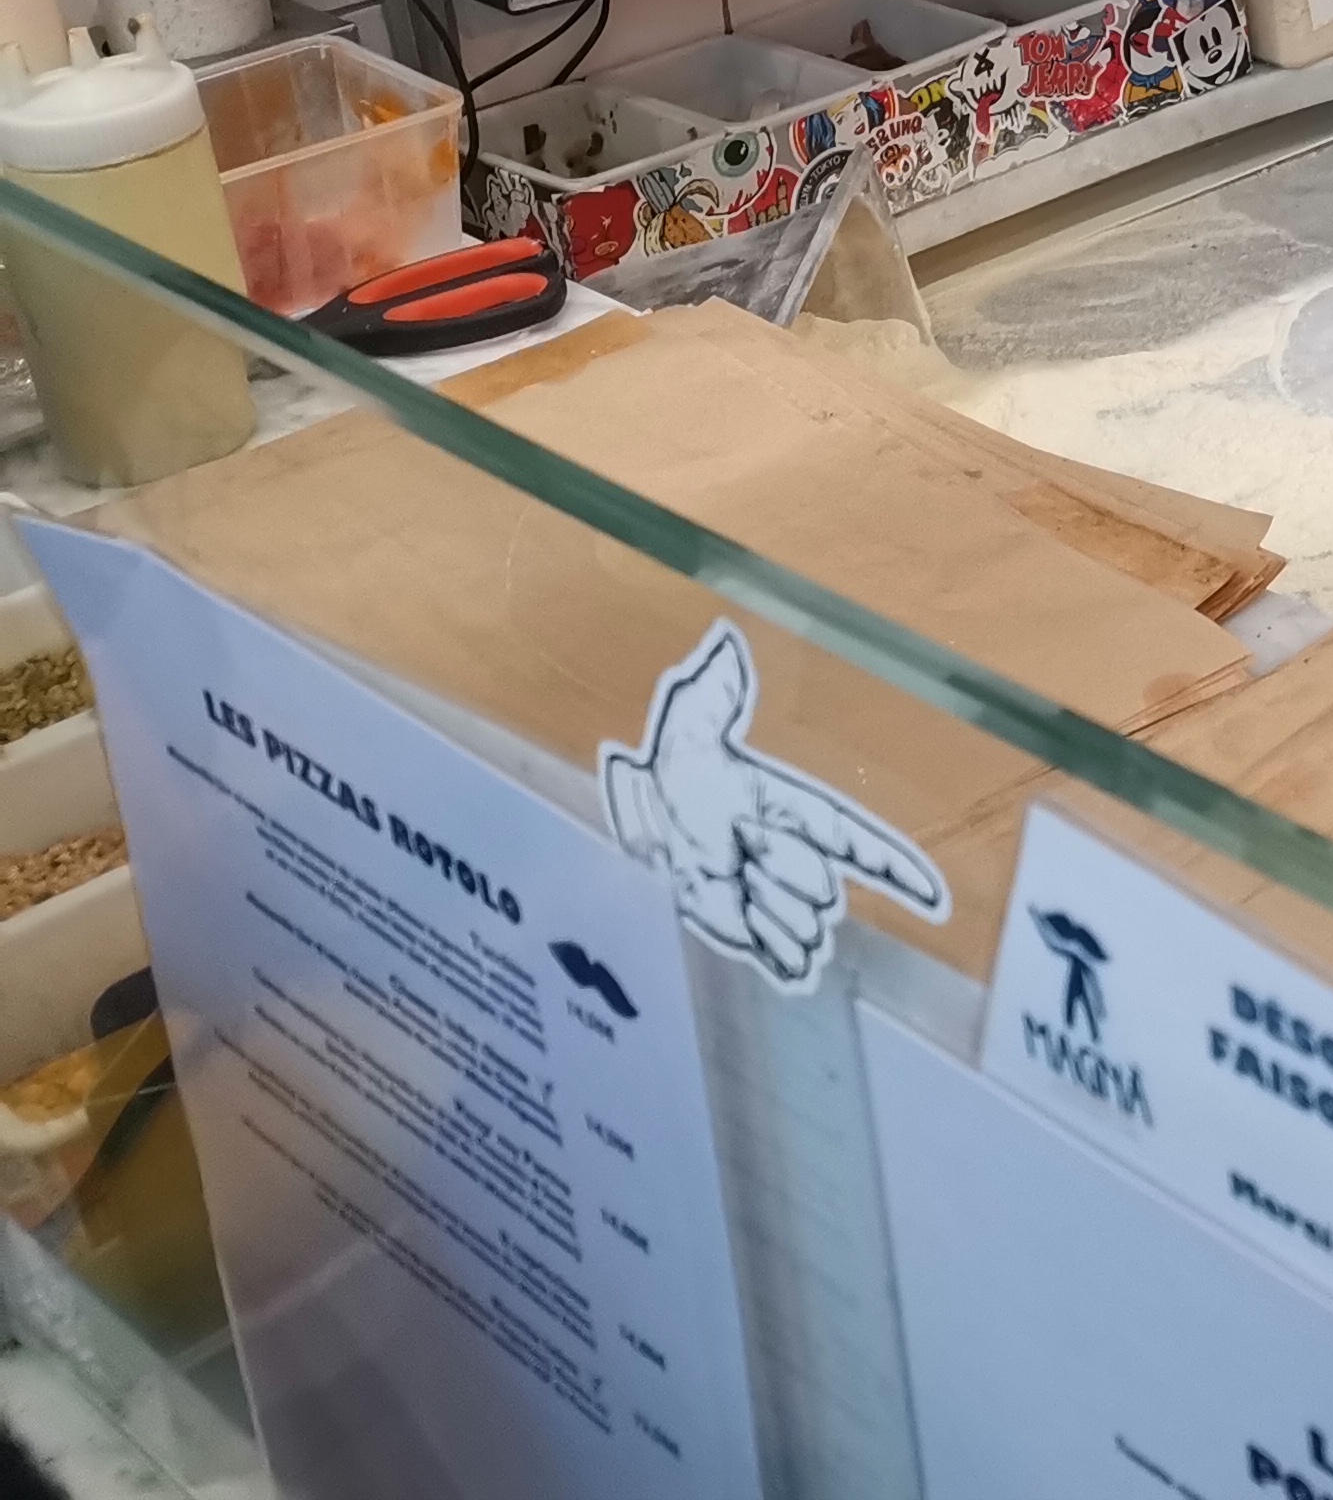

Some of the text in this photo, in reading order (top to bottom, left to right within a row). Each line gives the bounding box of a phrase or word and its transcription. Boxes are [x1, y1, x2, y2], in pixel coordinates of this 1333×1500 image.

[1013, 30, 1067, 64] TOM
[1017, 62, 1101, 99] JERRY
[811, 155, 841, 180] TOKYO
[203, 689, 522, 925] LES PIZZAS ROTOLO
[1022, 1011, 1153, 1128] MAGMA
[1229, 1170, 1333, 1252] Merci
